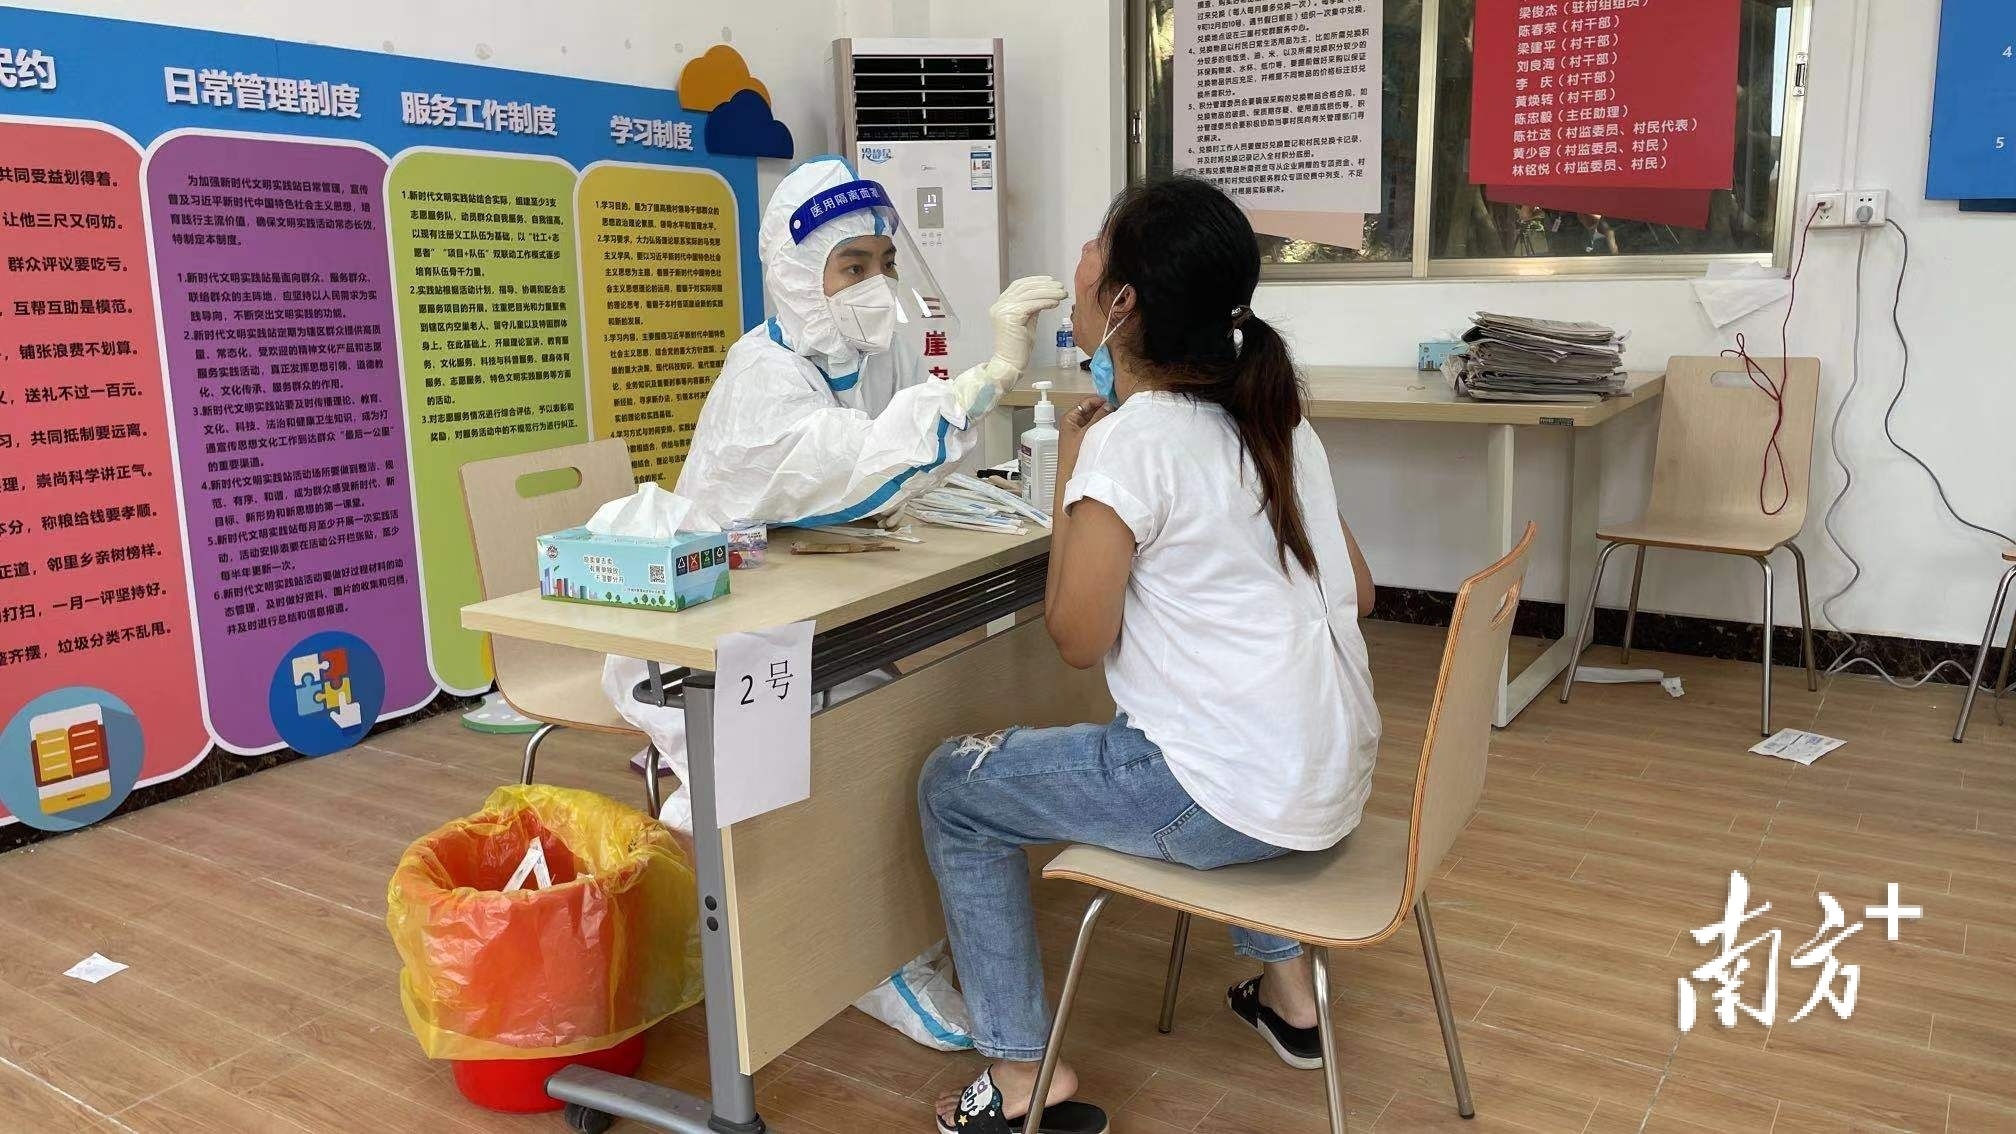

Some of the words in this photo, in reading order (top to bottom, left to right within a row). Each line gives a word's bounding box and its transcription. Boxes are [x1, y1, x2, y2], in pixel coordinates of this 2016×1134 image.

[1518, 15, 1620, 37] 陈春荣（村干部）
[1517, 33, 1620, 55] 梁建平（村干部）
[2002, 46, 2012, 57] 4
[163, 66, 361, 119] 日常管理制度
[400, 91, 558, 136] 服务工作制度
[1514, 105, 1629, 126] 陈忠毅（主任助理）
[610, 114, 694, 150] 学习制度
[1995, 136, 2005, 149] 5
[2, 211, 123, 230] 让他三尺又何妨。
[172, 234, 242, 246] 特制定本制度。
[8, 256, 128, 272] 群众评议要吃亏。
[0, 343, 138, 361] ，铺张浪费不划算。
[427, 395, 455, 406] 的活动。
[207, 457, 264, 472] 的重要渠道。
[0, 463, 153, 493] 理，崇尚科学讲正气。
[0, 582, 166, 623] 打扫，一月一评坚持好。
